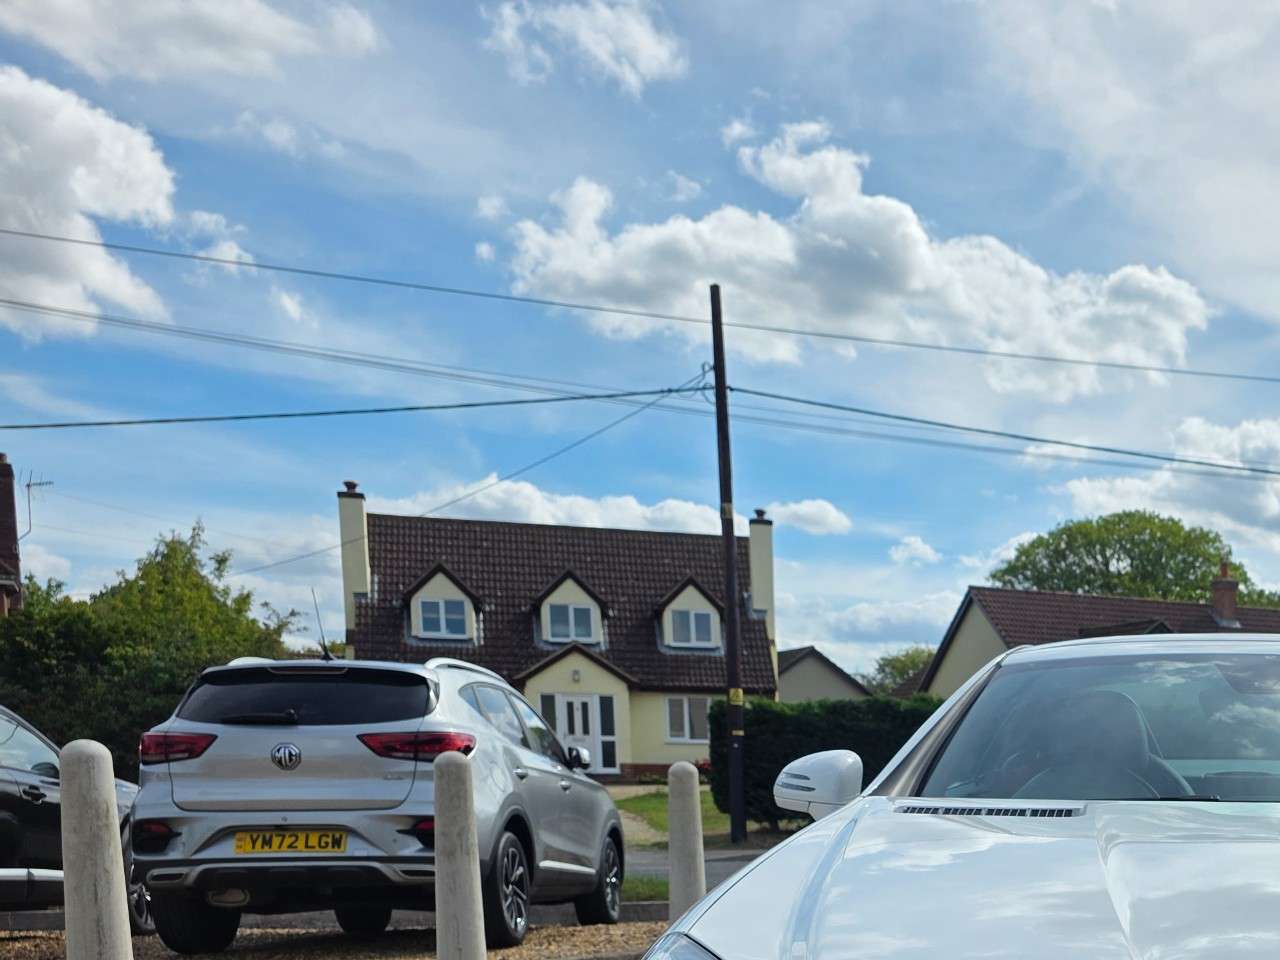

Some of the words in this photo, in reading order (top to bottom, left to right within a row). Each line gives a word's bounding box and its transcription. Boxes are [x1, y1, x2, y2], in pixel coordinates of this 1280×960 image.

[273, 744, 299, 769] MG
[249, 833, 299, 850] YM72
[304, 833, 343, 849] LGW
